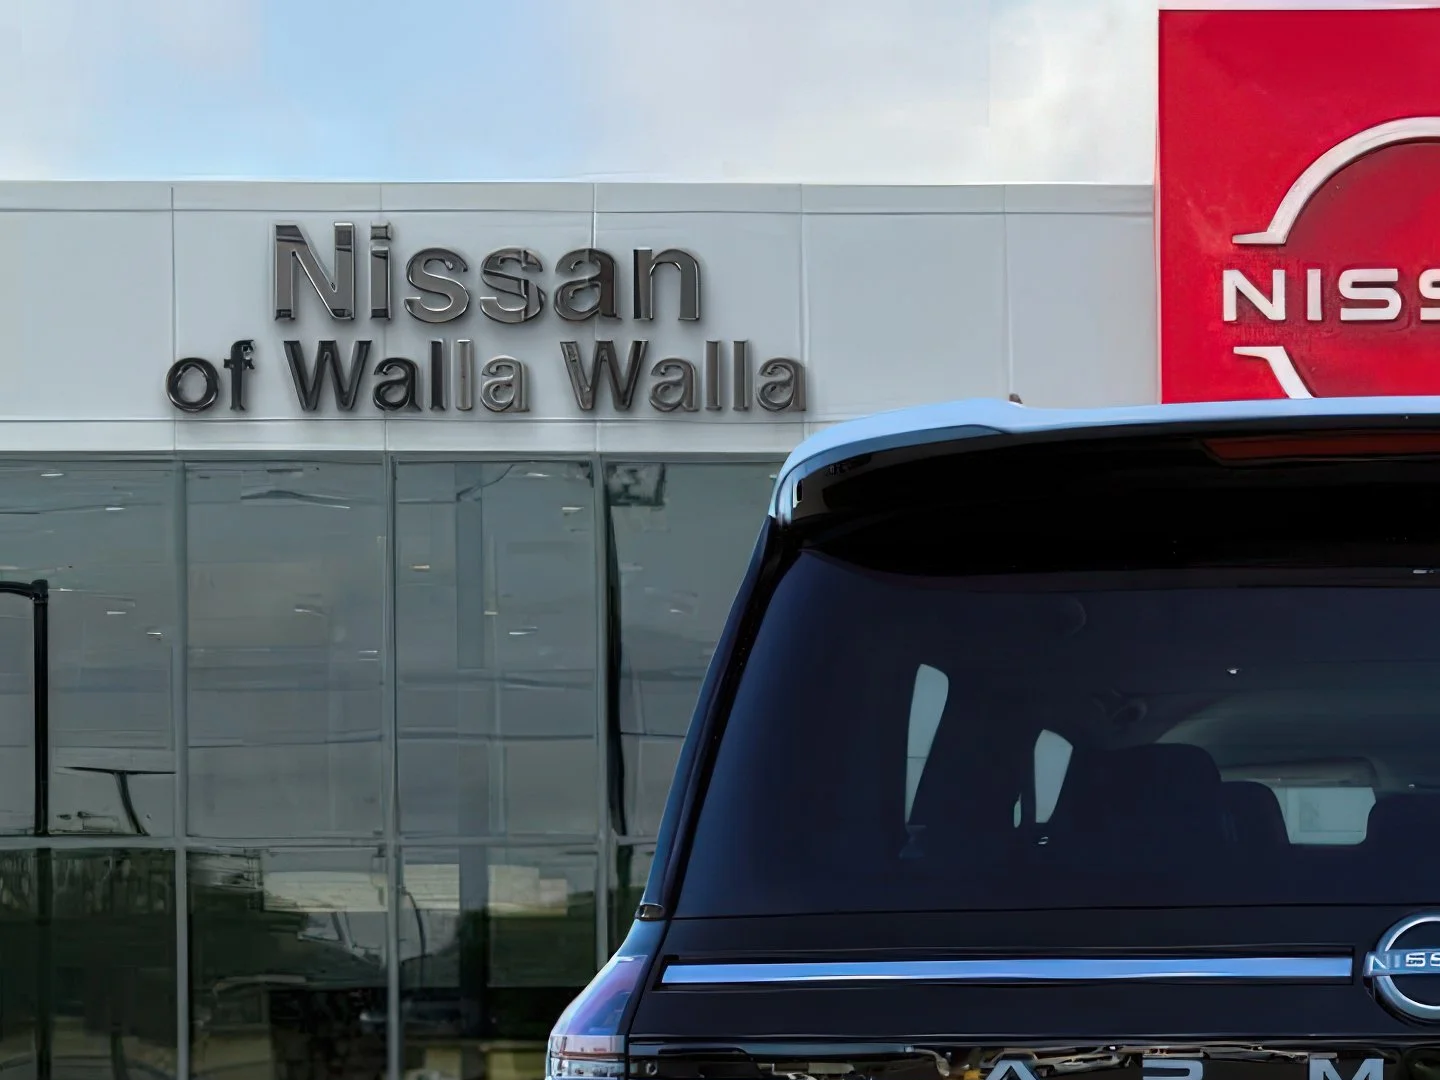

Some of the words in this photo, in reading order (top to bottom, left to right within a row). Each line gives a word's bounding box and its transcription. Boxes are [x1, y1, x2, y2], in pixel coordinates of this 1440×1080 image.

[272, 220, 703, 322] Nissan
[166, 339, 256, 413] of
[284, 340, 530, 413] Walla
[560, 340, 808, 413] Walla
